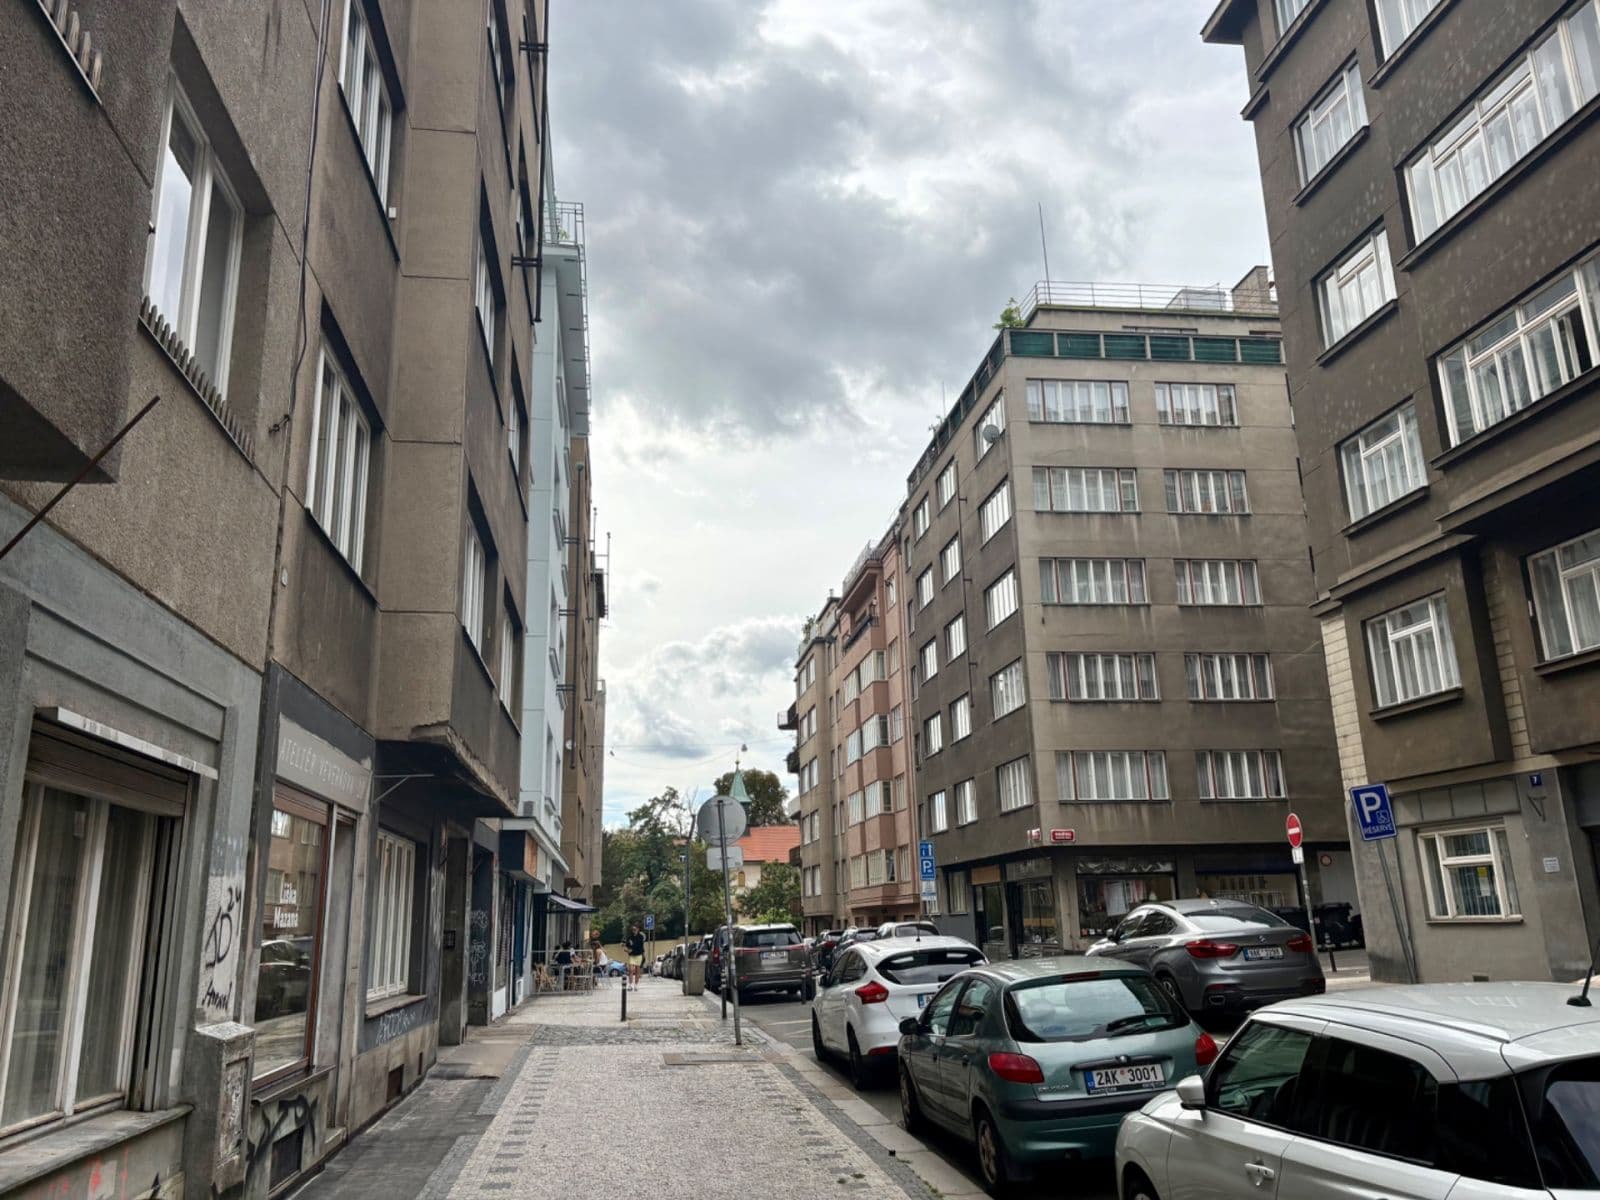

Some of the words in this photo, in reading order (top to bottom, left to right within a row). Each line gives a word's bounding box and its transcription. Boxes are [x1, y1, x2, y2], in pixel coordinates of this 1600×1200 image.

[1532, 776, 1538, 785] 7
[1359, 791, 1381, 823] P
[922, 860, 932, 873] P
[1096, 1070, 1120, 1086] 2AK
[1127, 1066, 1158, 1082] 3001
